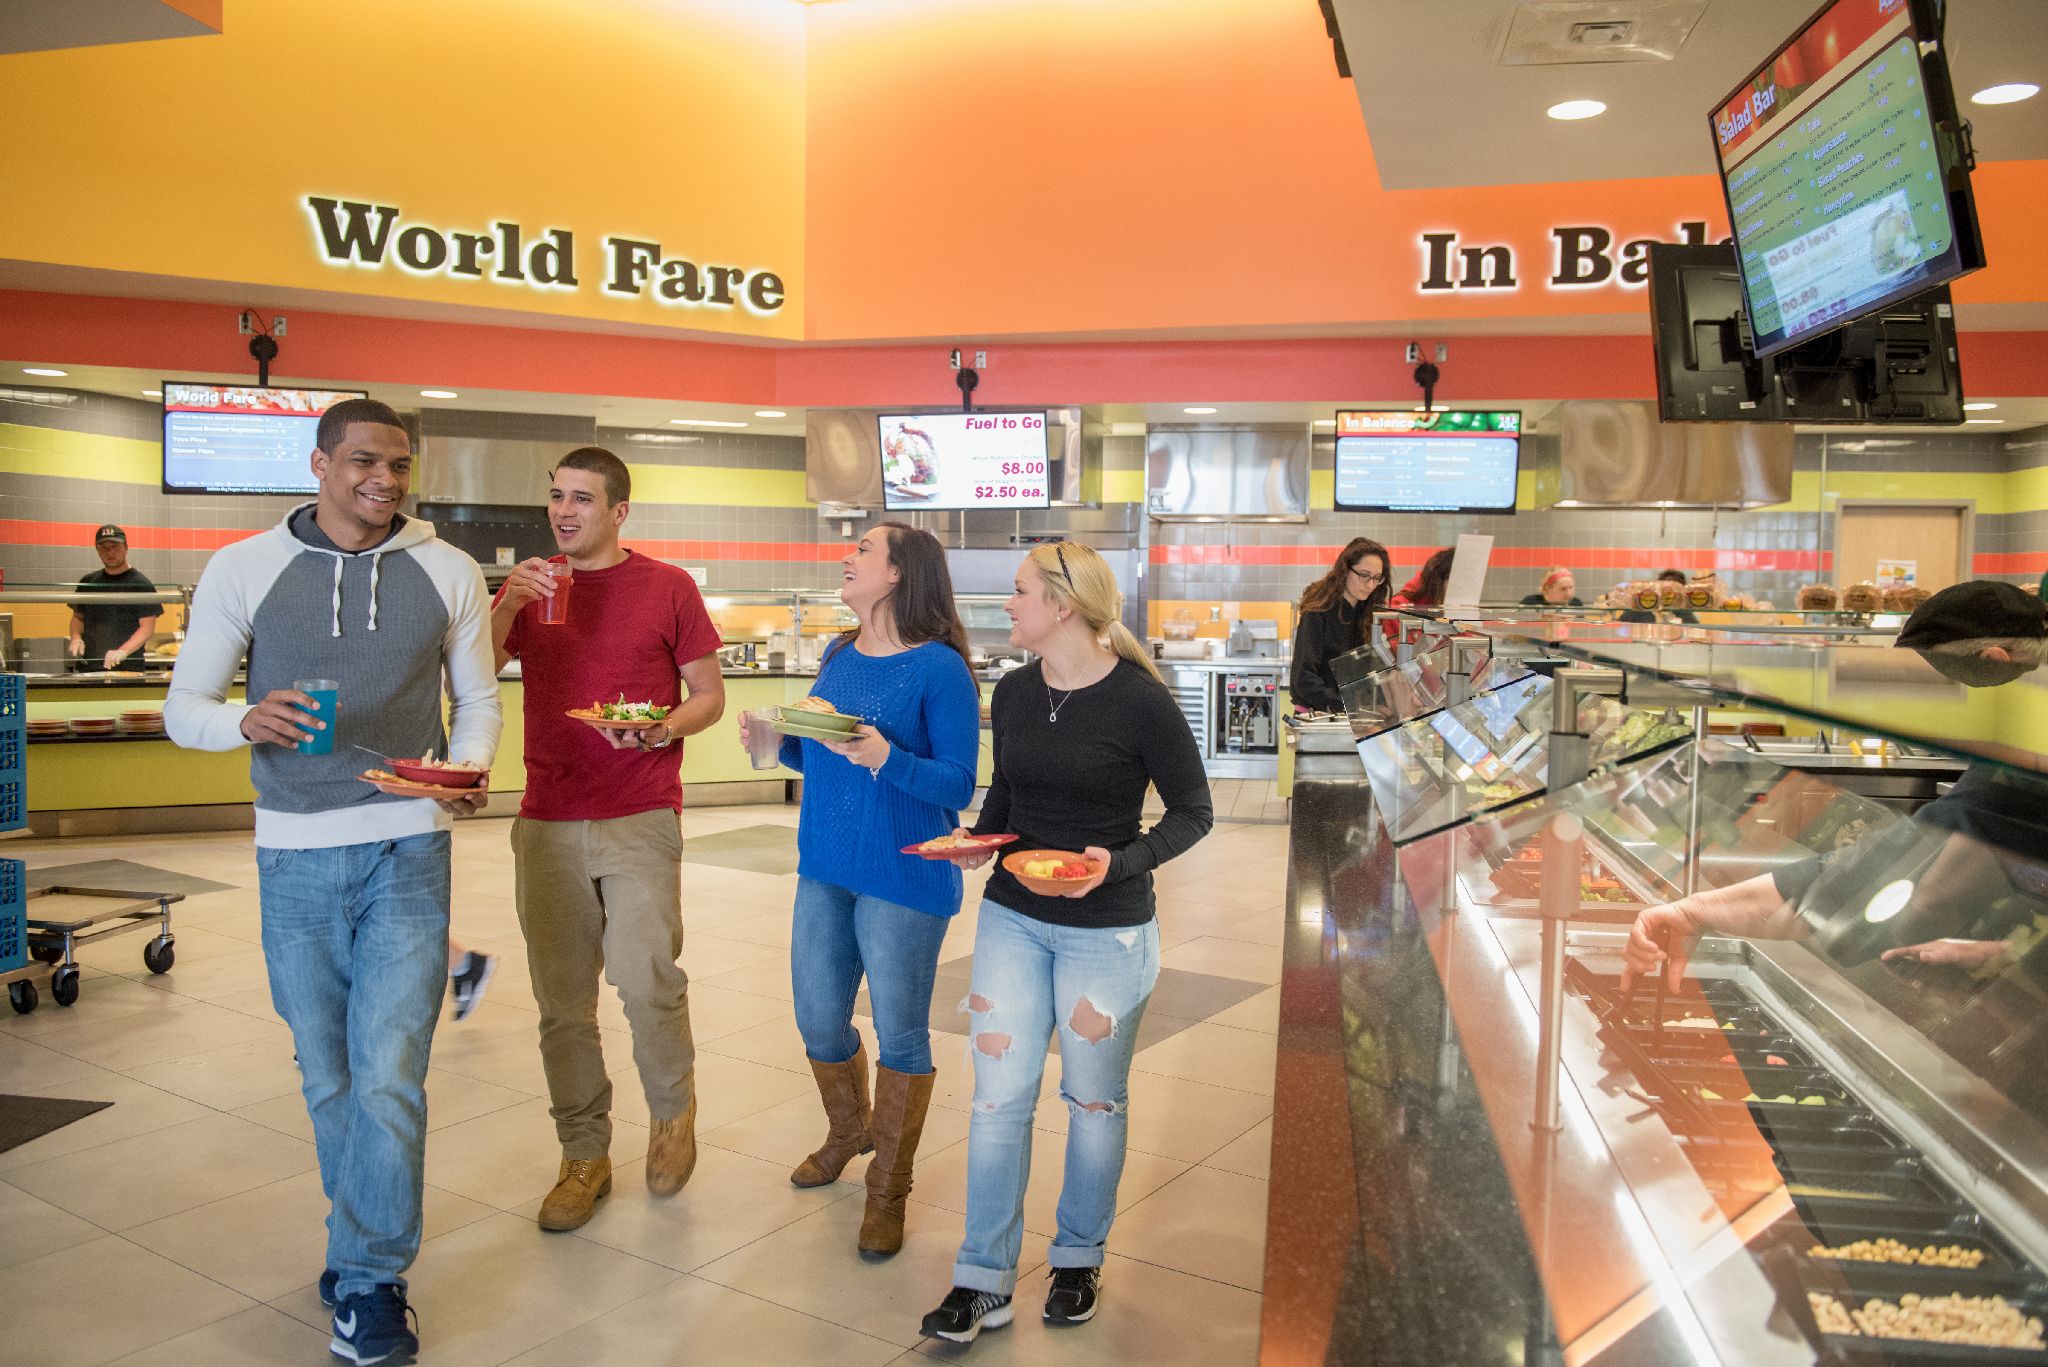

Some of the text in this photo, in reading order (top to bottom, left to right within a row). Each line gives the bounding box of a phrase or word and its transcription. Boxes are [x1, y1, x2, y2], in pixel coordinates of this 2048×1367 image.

[1718, 99, 1752, 145] Salad
[1751, 83, 1775, 118] Bar
[307, 196, 785, 312] World Fare
[1421, 233, 1517, 290] In
[175, 390, 257, 405] World Fare
[965, 416, 1042, 430] Fuel to Go
[1345, 416, 1416, 428] In Balance
[1002, 462, 1044, 475] $8.00
[975, 485, 1045, 499] $2.50 ea.
